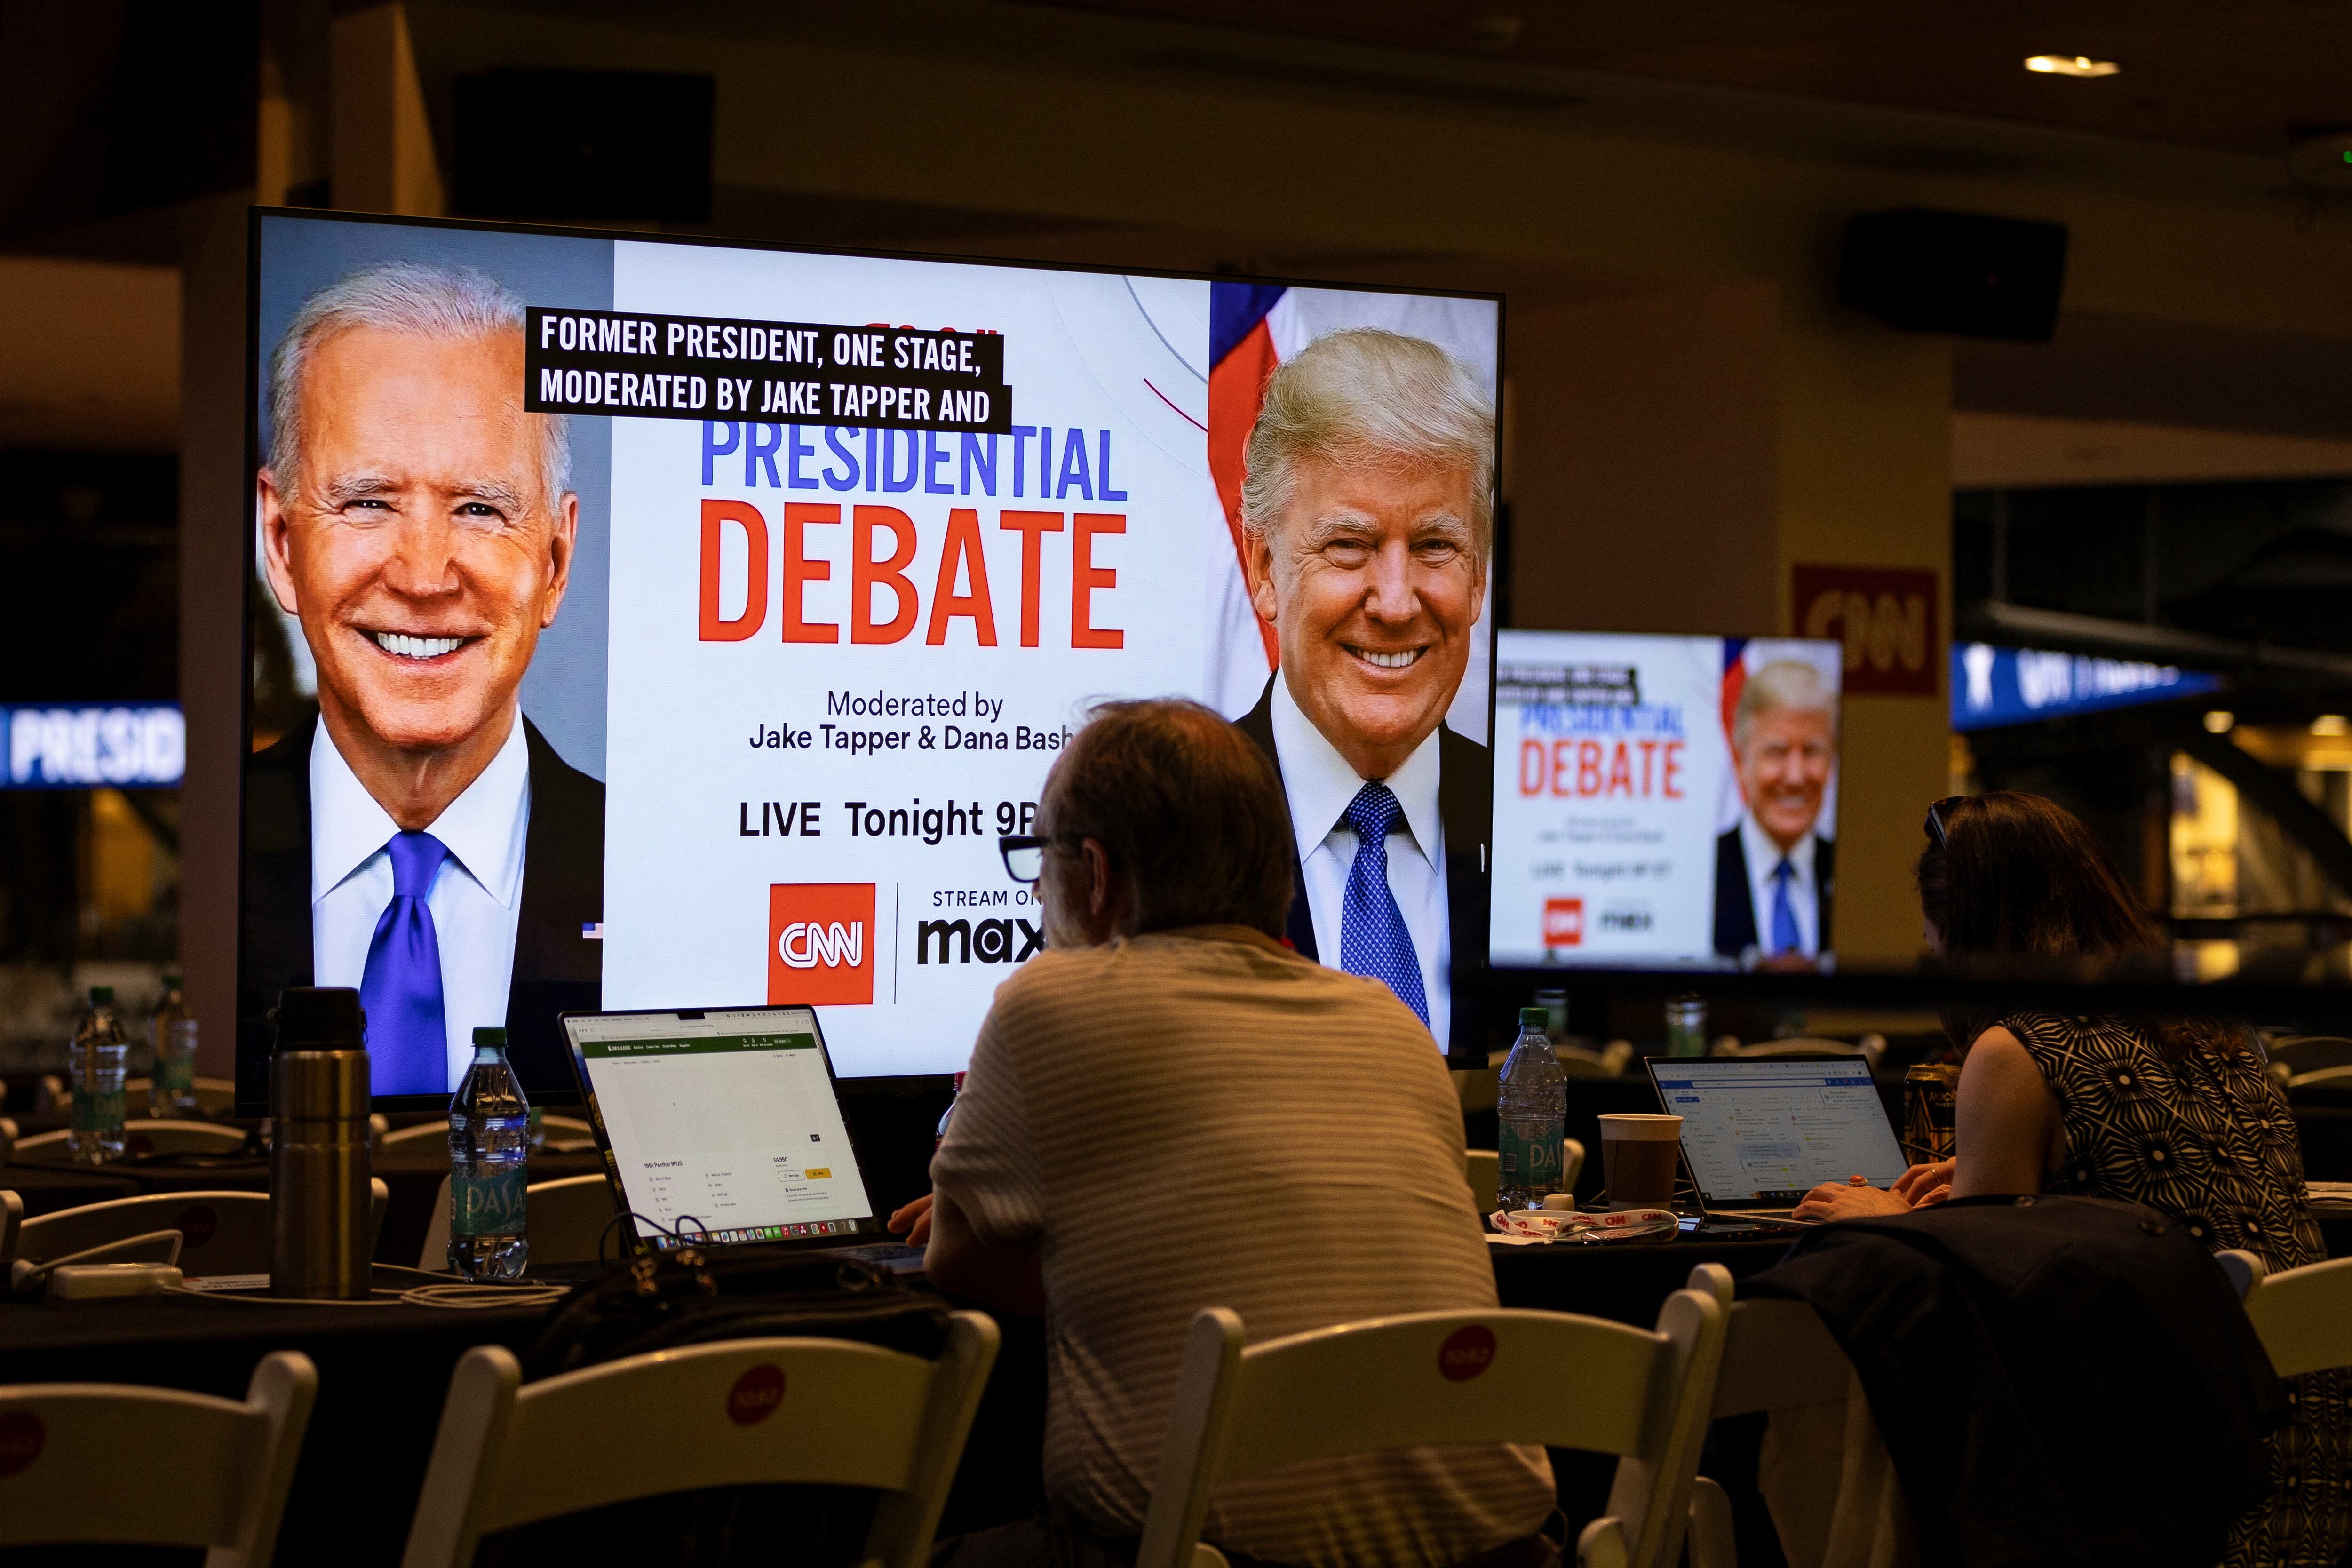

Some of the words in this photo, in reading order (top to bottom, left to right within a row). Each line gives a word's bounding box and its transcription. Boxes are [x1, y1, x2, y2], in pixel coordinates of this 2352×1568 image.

[541, 316, 658, 355] FORMER
[667, 323, 823, 369] PRESIDENT,
[834, 332, 884, 367] ONE
[894, 337, 981, 377] STAGE,
[541, 369, 707, 409] MODERATED
[717, 379, 753, 411] BY
[761, 381, 820, 414] JAKE
[830, 384, 930, 421] TAPPER
[939, 389, 989, 423] AND
[701, 420, 1128, 501] PRESIDENTIAL
[699, 499, 1127, 649] DEBATE
[828, 690, 967, 716] Moderated
[975, 692, 1003, 723] by
[749, 723, 812, 749] Jake
[820, 724, 910, 756] Tapper
[918, 725, 936, 750] &
[945, 725, 1009, 750] Dana
[1016, 725, 1074, 750] Bash
[1519, 739, 1687, 798] DEBATE
[740, 802, 821, 837] LIVE
[844, 798, 983, 845] Tonight
[933, 890, 1008, 907] STREAM
[778, 921, 863, 969] CNN
[917, 918, 1047, 964] max
[1605, 1215, 1625, 1225] CNN
